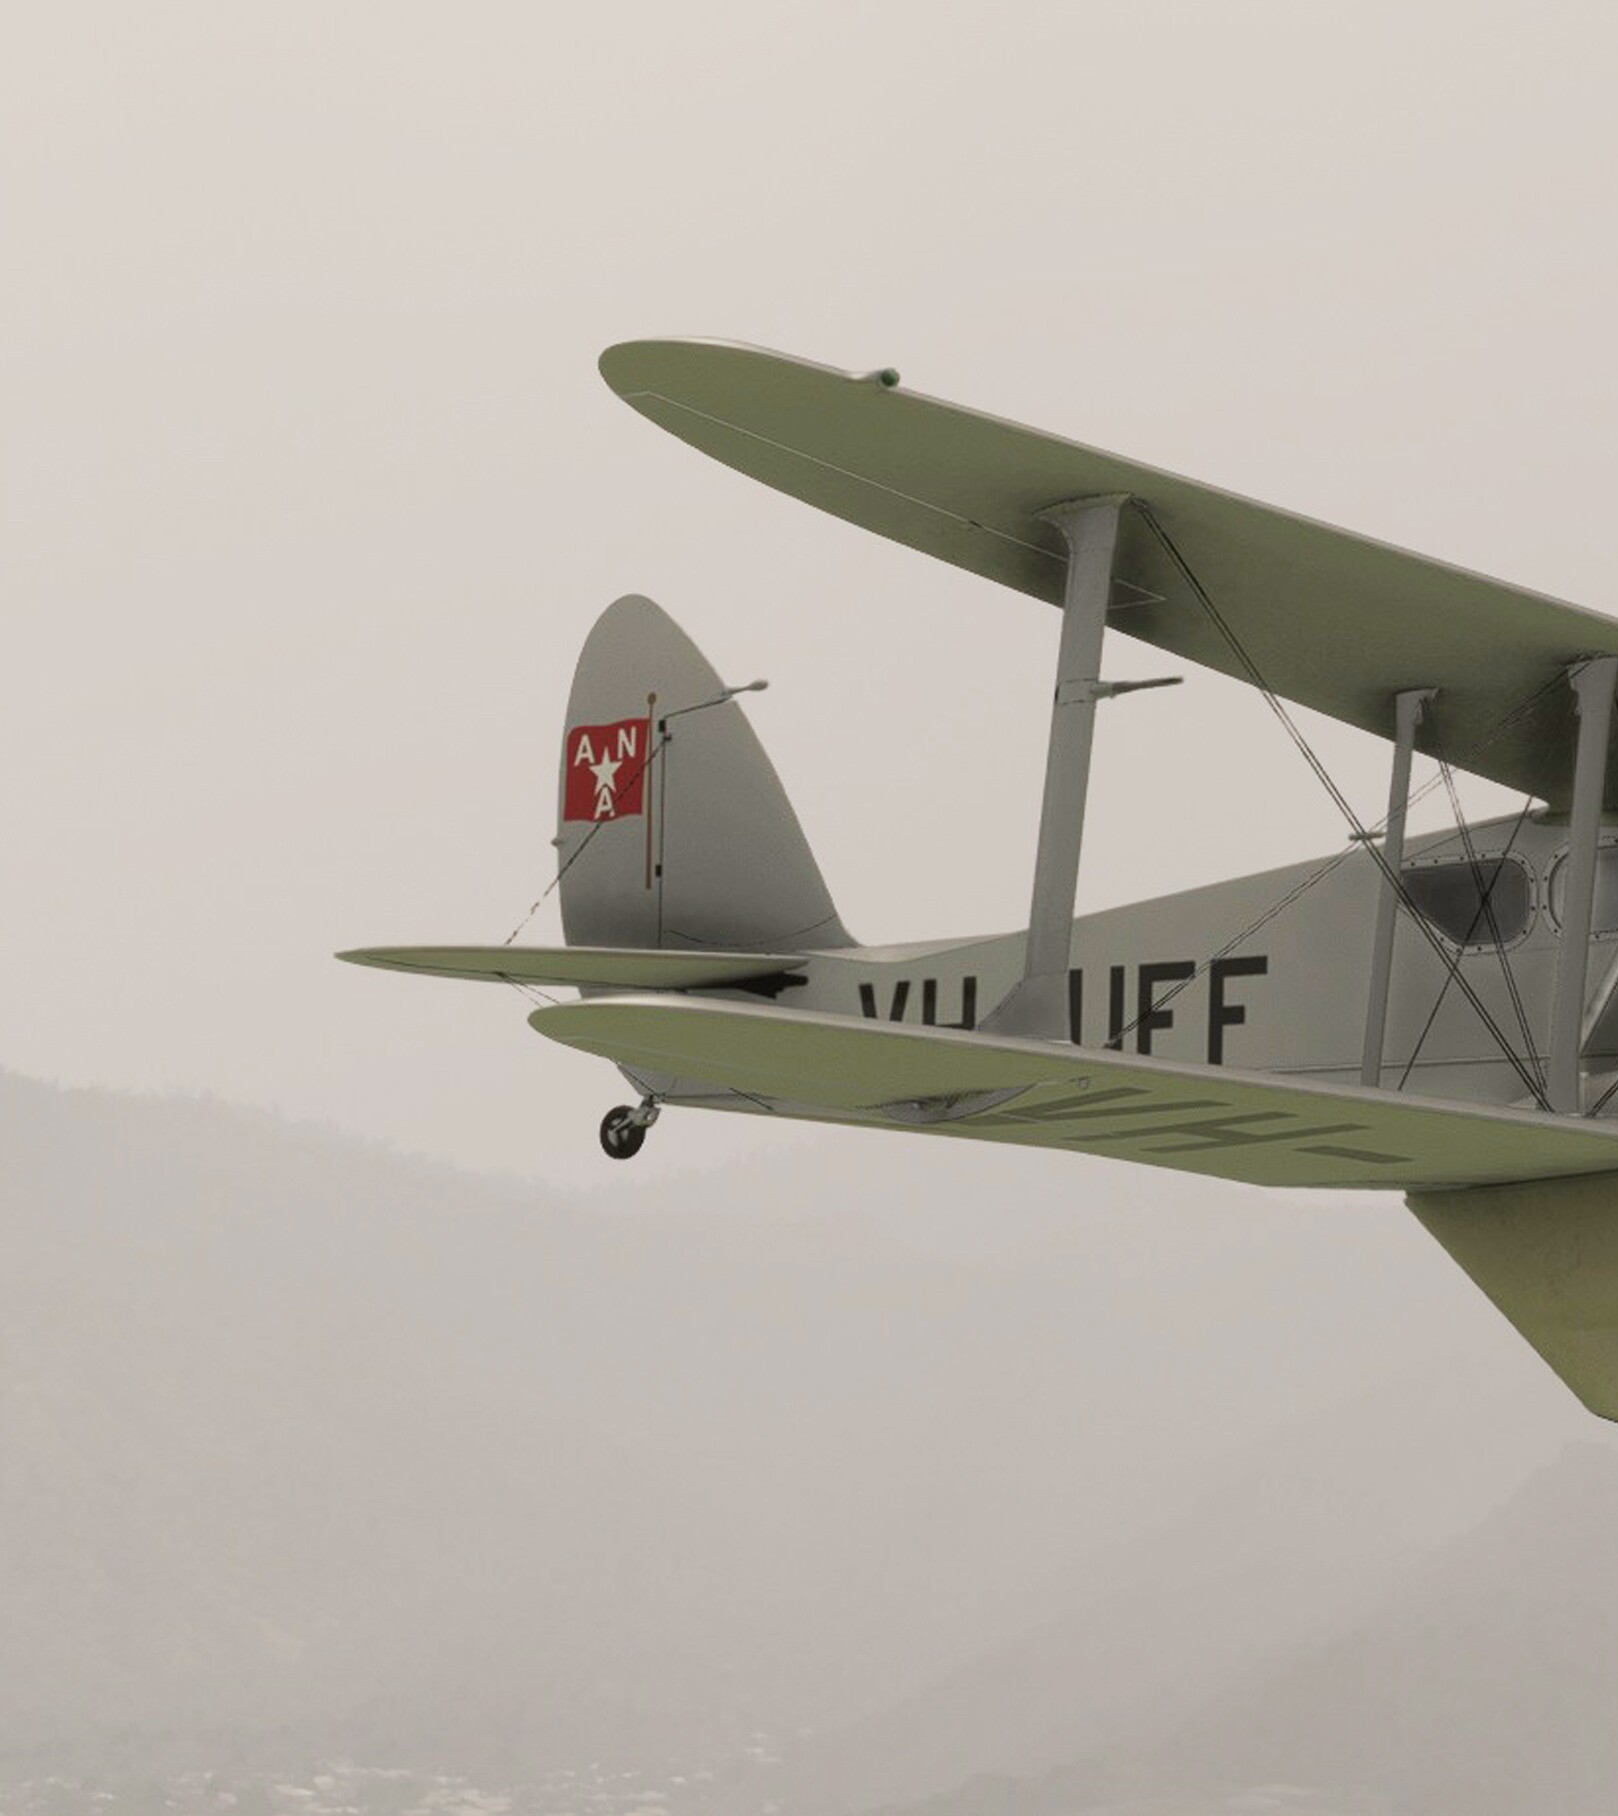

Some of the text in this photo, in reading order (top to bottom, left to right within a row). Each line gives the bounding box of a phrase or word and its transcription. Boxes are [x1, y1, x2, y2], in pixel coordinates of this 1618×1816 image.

[574, 725, 637, 767] A N
[594, 785, 615, 819] A
